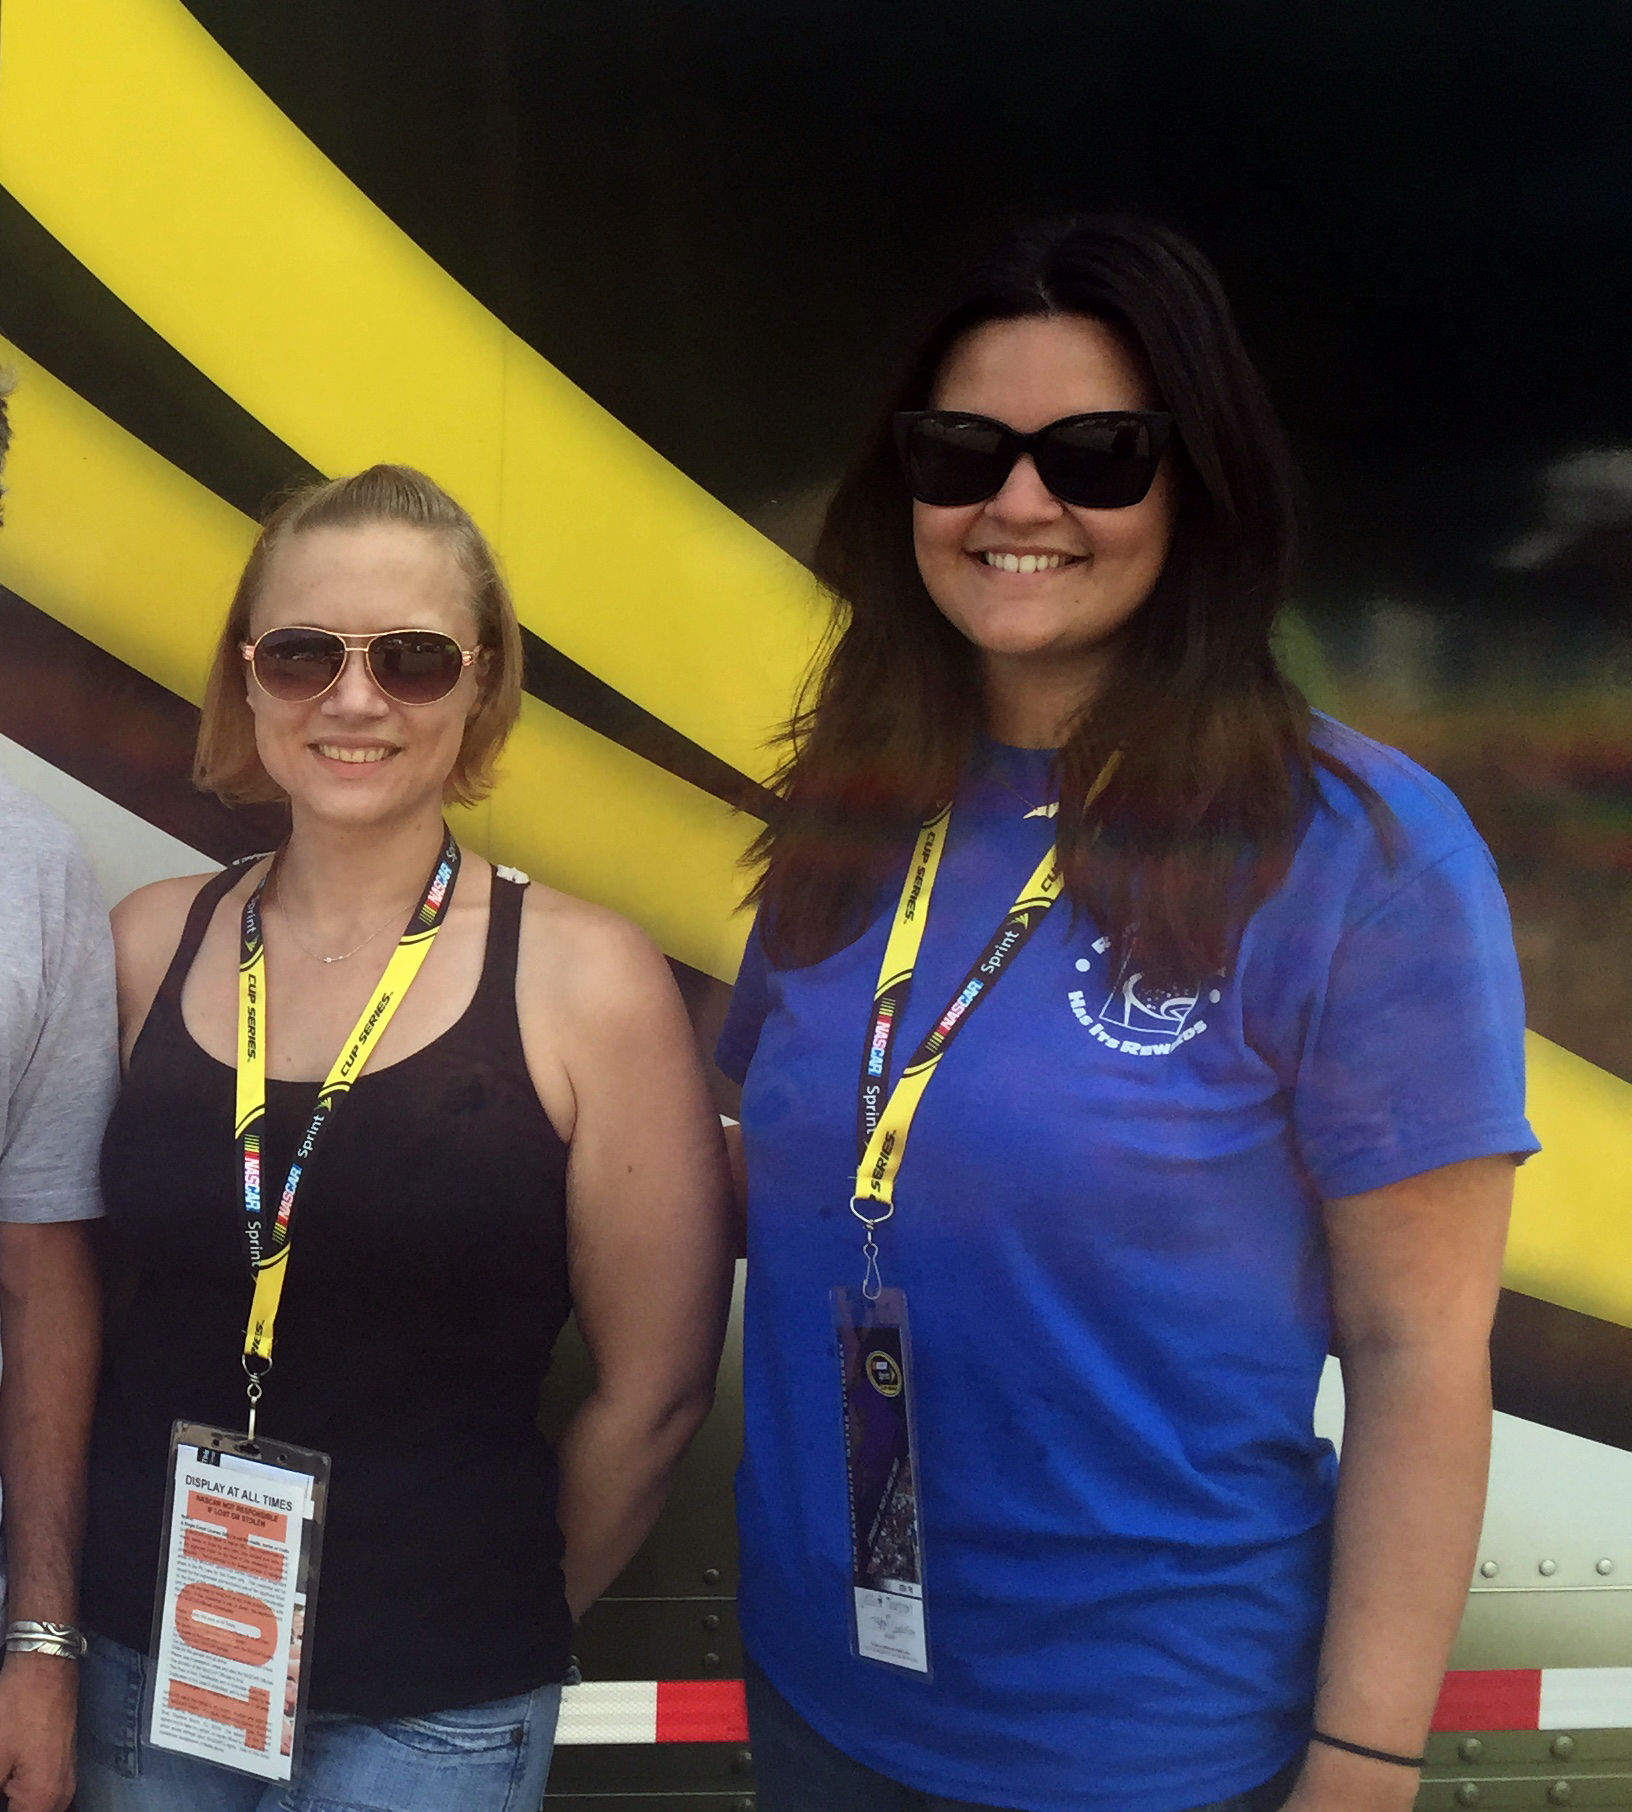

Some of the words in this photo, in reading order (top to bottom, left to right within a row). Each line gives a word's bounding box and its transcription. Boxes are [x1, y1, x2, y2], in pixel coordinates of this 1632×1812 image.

[923, 831, 936, 864] CUP
[427, 863, 453, 908] NASCAR
[905, 866, 926, 921] SERIES
[1041, 865, 1062, 892] CU
[248, 973, 257, 1004] CUP
[941, 979, 985, 1031] NASCAR
[980, 930, 1019, 975] Sprint
[247, 1006, 256, 1060] SERIES
[1068, 990, 1094, 1026] HAS
[340, 1045, 359, 1078] CUP
[358, 992, 391, 1045] SERIES
[869, 1020, 891, 1075] NASCAR
[865, 1085, 880, 1135] Sprint
[244, 1157, 261, 1211] NASCAR
[277, 1166, 302, 1221] NASCAR
[297, 1114, 325, 1158] Sprint
[871, 1131, 895, 1193] SERIES
[244, 1220, 262, 1268] Sprint
[185, 1475, 225, 1493] DISPLAY
[227, 1486, 240, 1498] AT
[241, 1490, 260, 1503] ALL
[262, 1495, 293, 1511] TIMES
